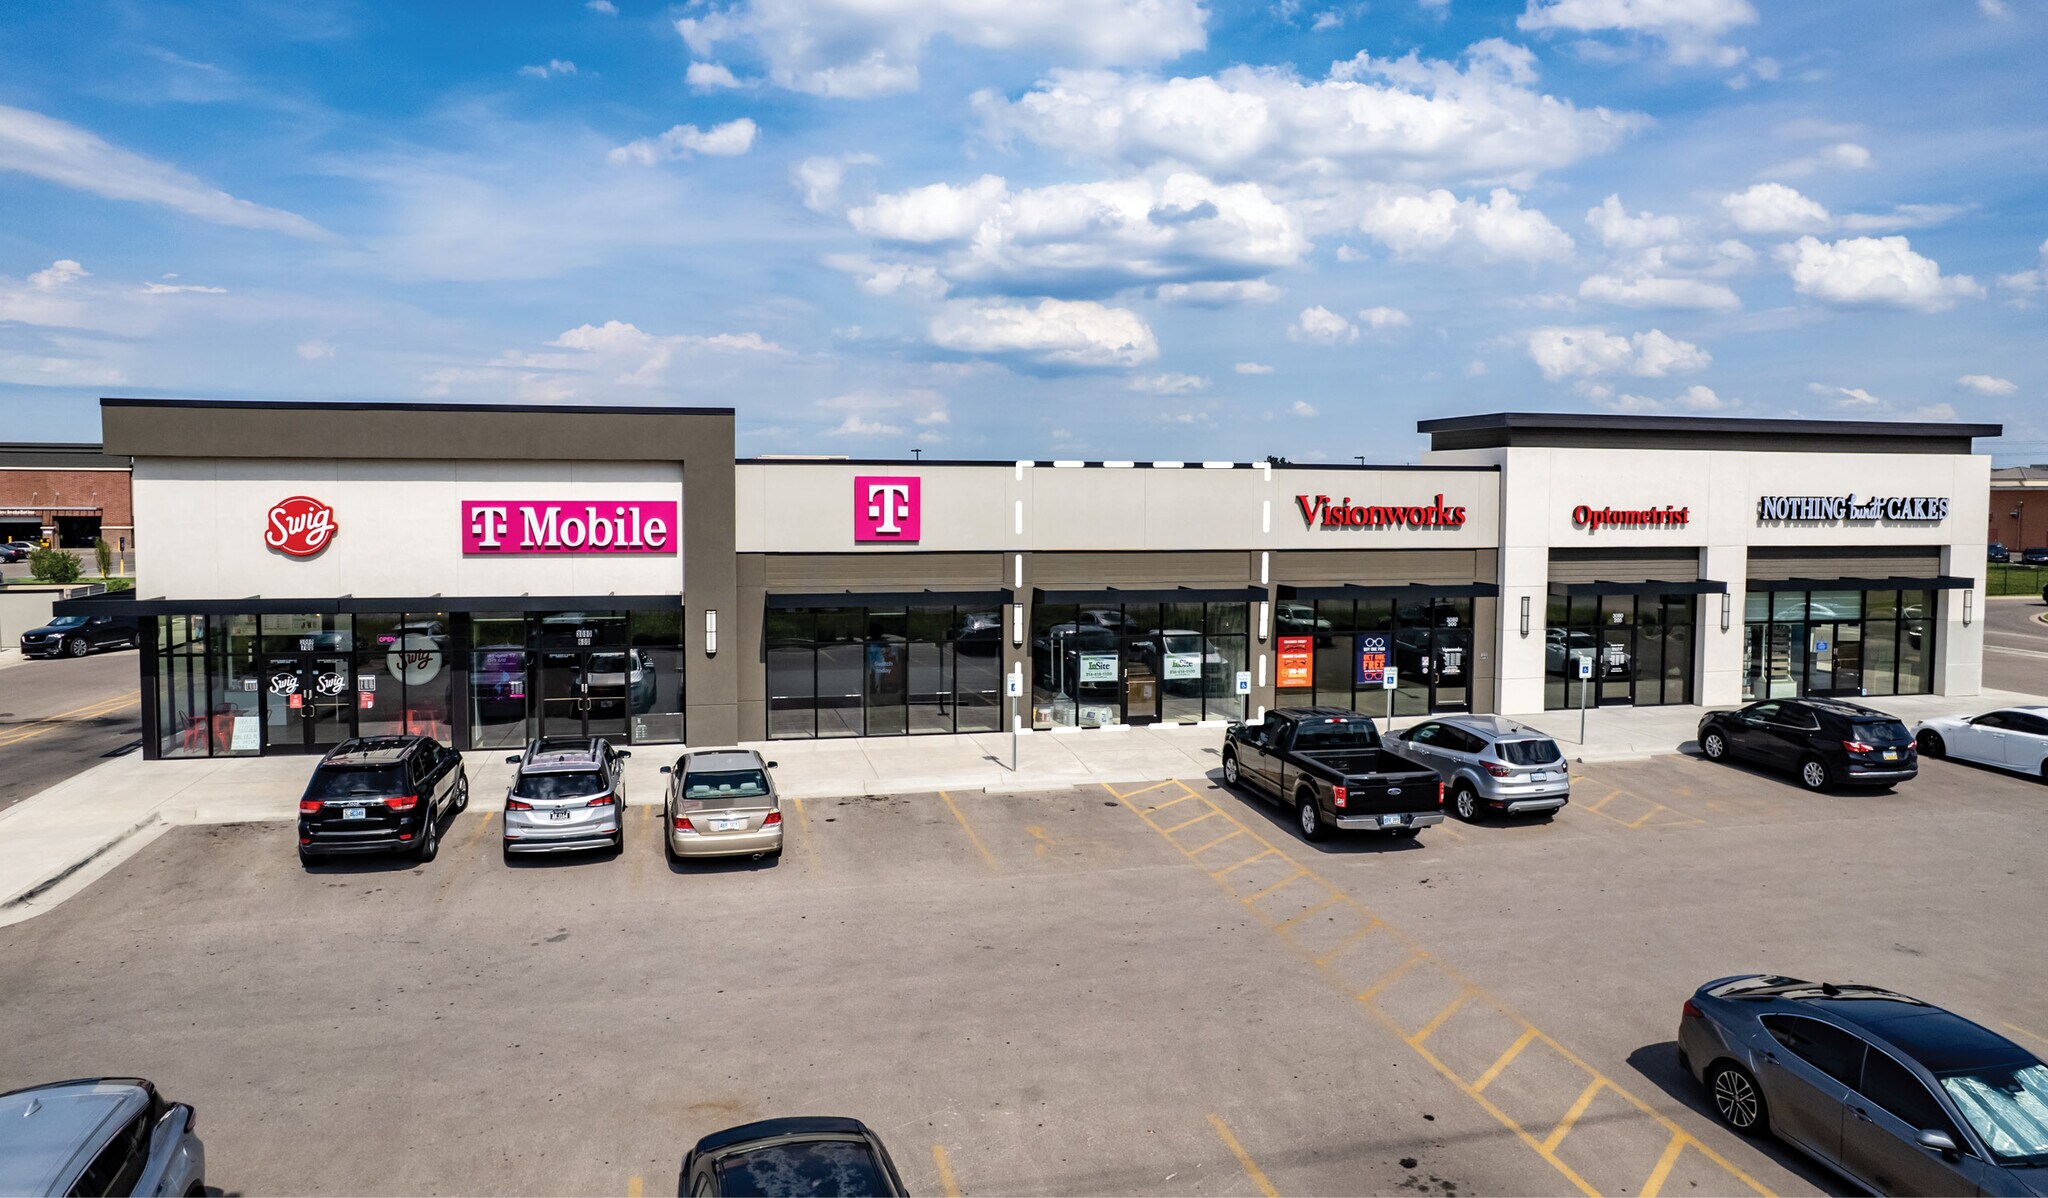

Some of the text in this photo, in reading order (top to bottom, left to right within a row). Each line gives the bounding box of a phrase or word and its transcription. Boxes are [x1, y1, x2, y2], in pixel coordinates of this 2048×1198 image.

[868, 484, 909, 533] T
[1296, 493, 1467, 526] Visionworks
[1572, 505, 1690, 530] Optometrist
[1762, 493, 1950, 520] NOTHING bundt CAKES
[266, 506, 335, 546] Swig
[519, 507, 667, 547] Mobile
[1088, 661, 1110, 670] InSite
[1363, 660, 1386, 670] FREE
[269, 675, 300, 693] Swig
[316, 675, 346, 693] Swig
